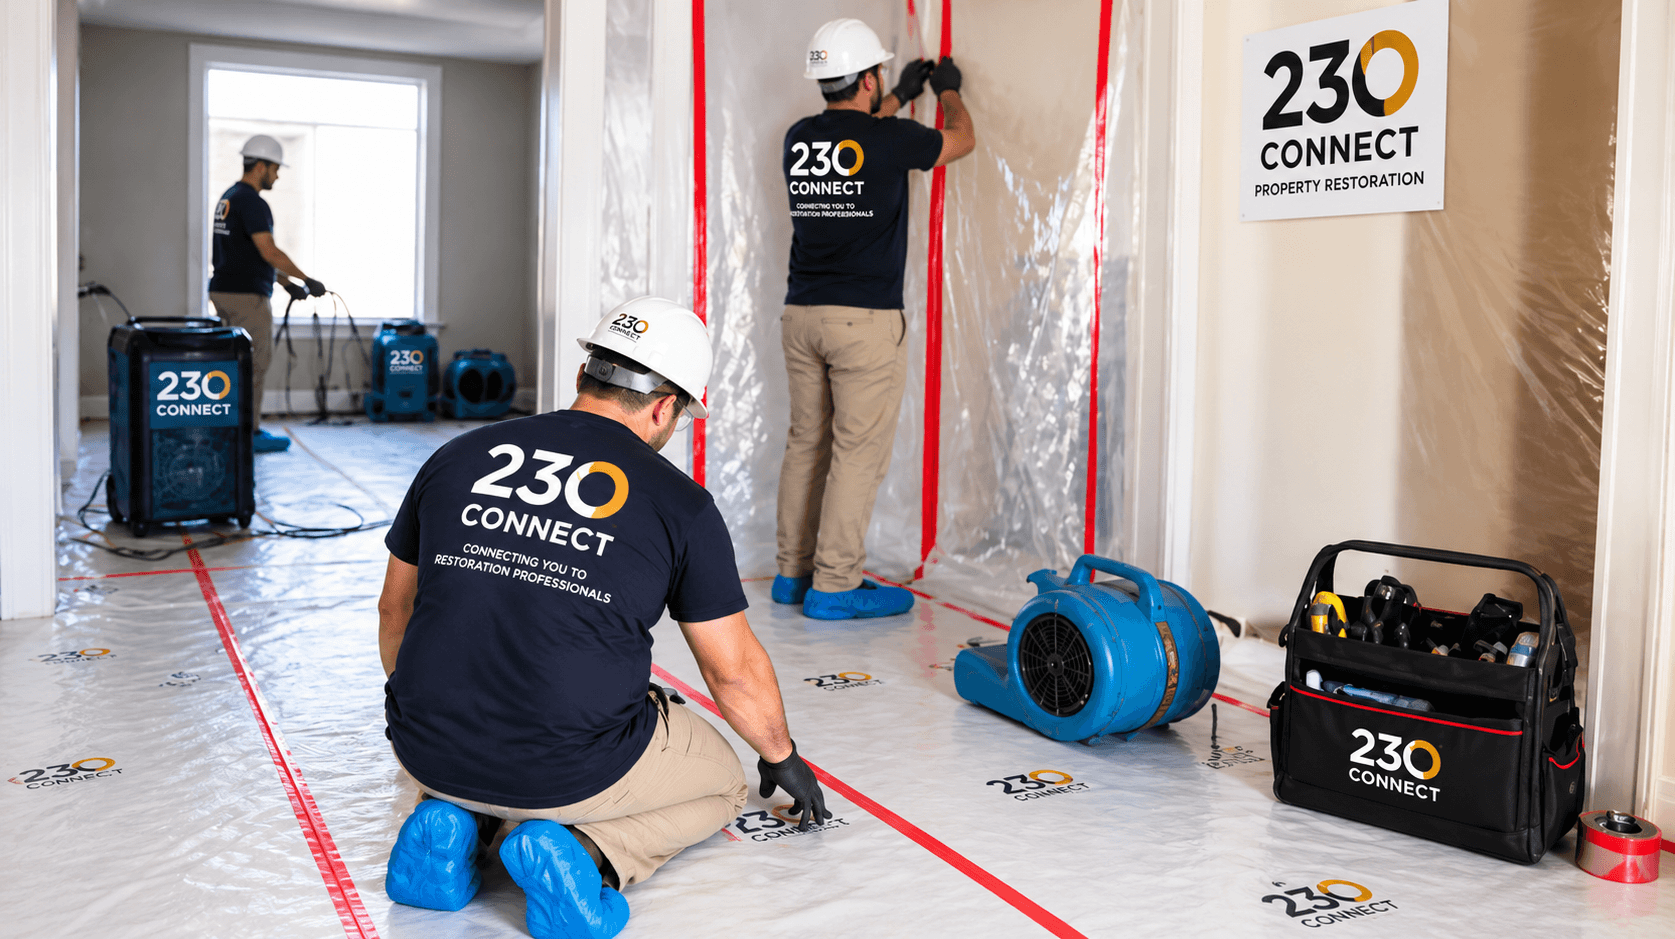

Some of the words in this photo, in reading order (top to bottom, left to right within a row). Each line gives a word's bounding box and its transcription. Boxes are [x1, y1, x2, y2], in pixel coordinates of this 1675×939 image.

[1262, 29, 1419, 130] 230
[789, 139, 864, 176] 230
[1260, 126, 1419, 170] CONNECT
[789, 181, 865, 195] CONNECT
[1254, 179, 1321, 197] PROPERTY
[1324, 171, 1424, 192] RESTORATION
[611, 312, 649, 334] 230
[390, 349, 424, 365] 230
[157, 370, 231, 401] 230
[156, 403, 231, 416] CONNECT
[470, 443, 629, 519] 230
[461, 503, 615, 557] CONNECT
[462, 543, 540, 568] CONNECTING
[542, 559, 568, 575] YOU
[571, 567, 588, 580] TO
[434, 554, 511, 577] RESTORATION
[512, 568, 612, 604] PROFESSIONALS
[37, 648, 111, 662] 230
[803, 671, 872, 688] 230
[1350, 728, 1441, 780] 230
[19, 757, 116, 783] 230
[26, 768, 123, 789] CONNECT
[985, 769, 1074, 795] 230
[1348, 767, 1441, 802] CONNECT
[1014, 782, 1090, 801] CONNECT
[1261, 879, 1373, 918] 230
[1301, 899, 1399, 928] CONNECT
